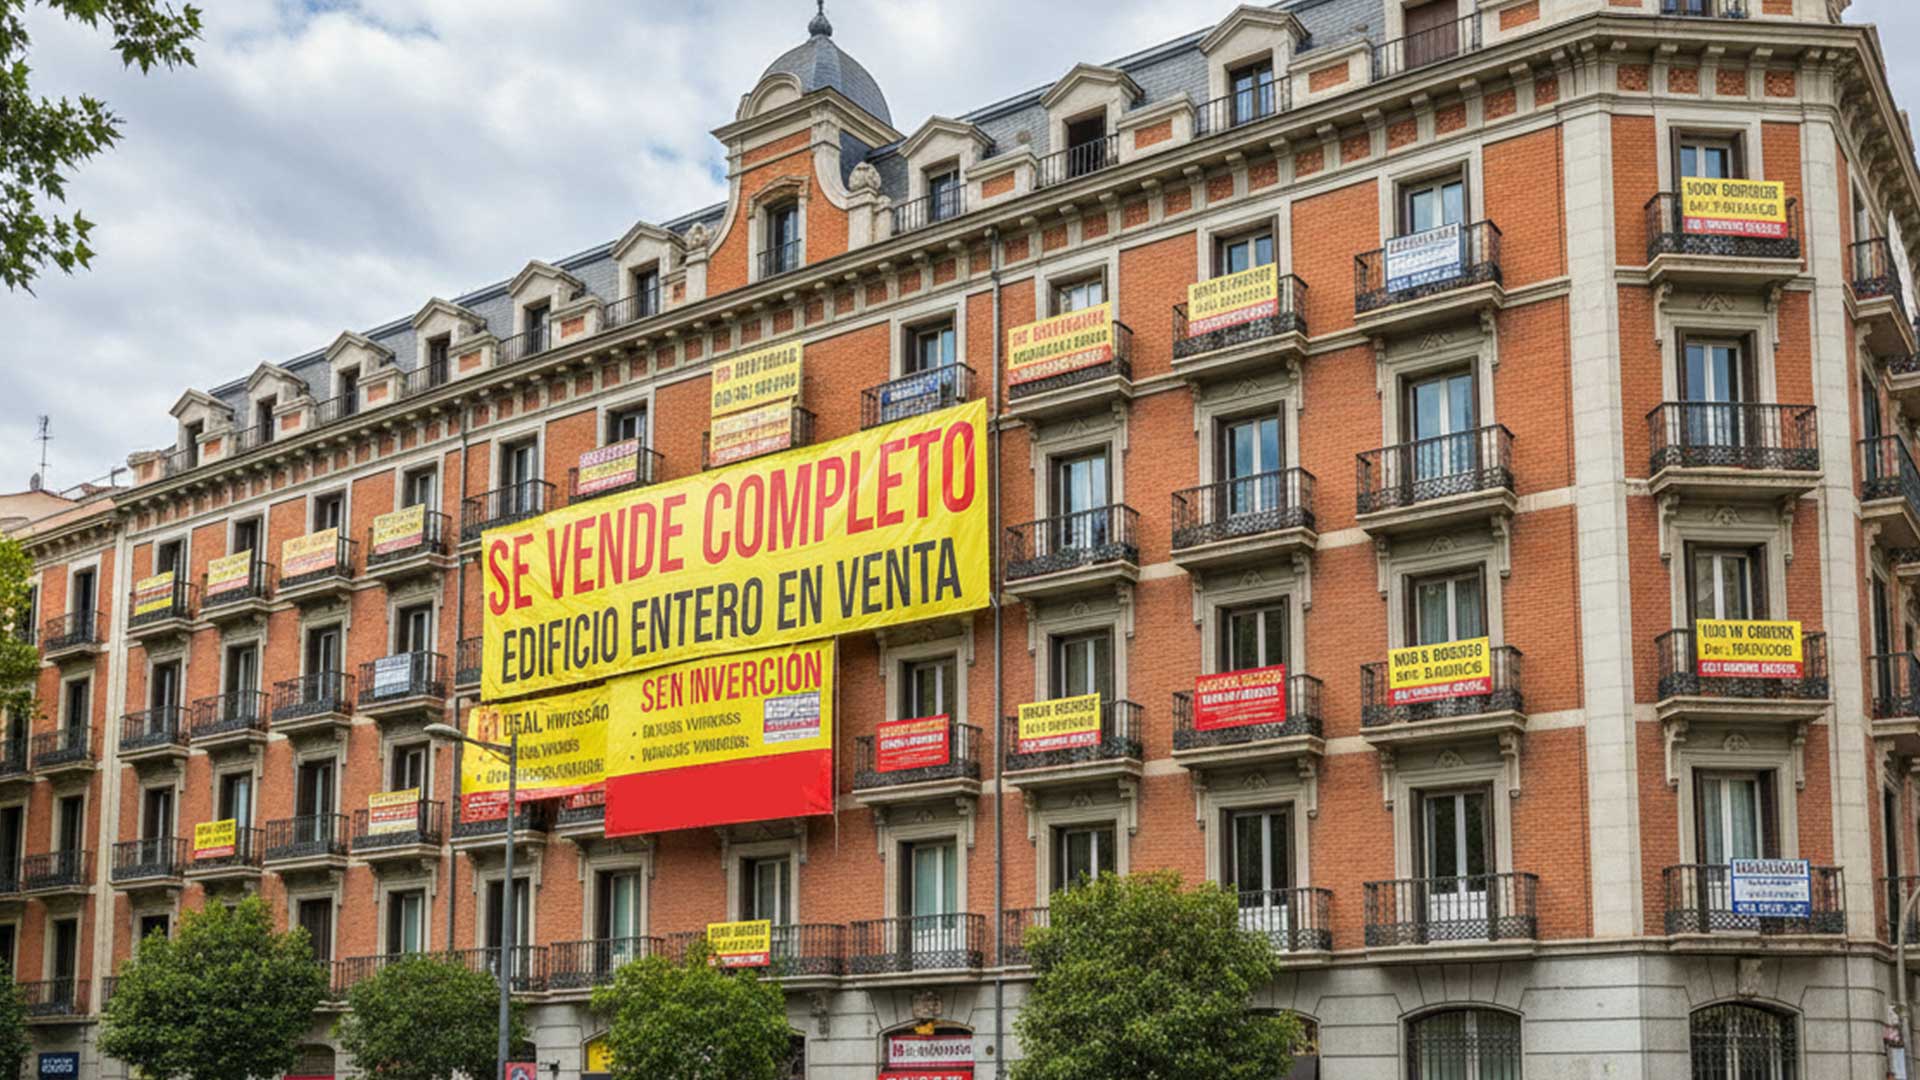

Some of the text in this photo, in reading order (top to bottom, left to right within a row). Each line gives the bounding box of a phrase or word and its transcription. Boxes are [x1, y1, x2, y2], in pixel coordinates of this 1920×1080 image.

[488, 534, 534, 616] SE
[547, 495, 686, 600] VENDE
[703, 421, 976, 565] COMPLETO
[502, 537, 963, 684] EDIFICIO ENTERO EN VENTA
[641, 673, 684, 713] SEN
